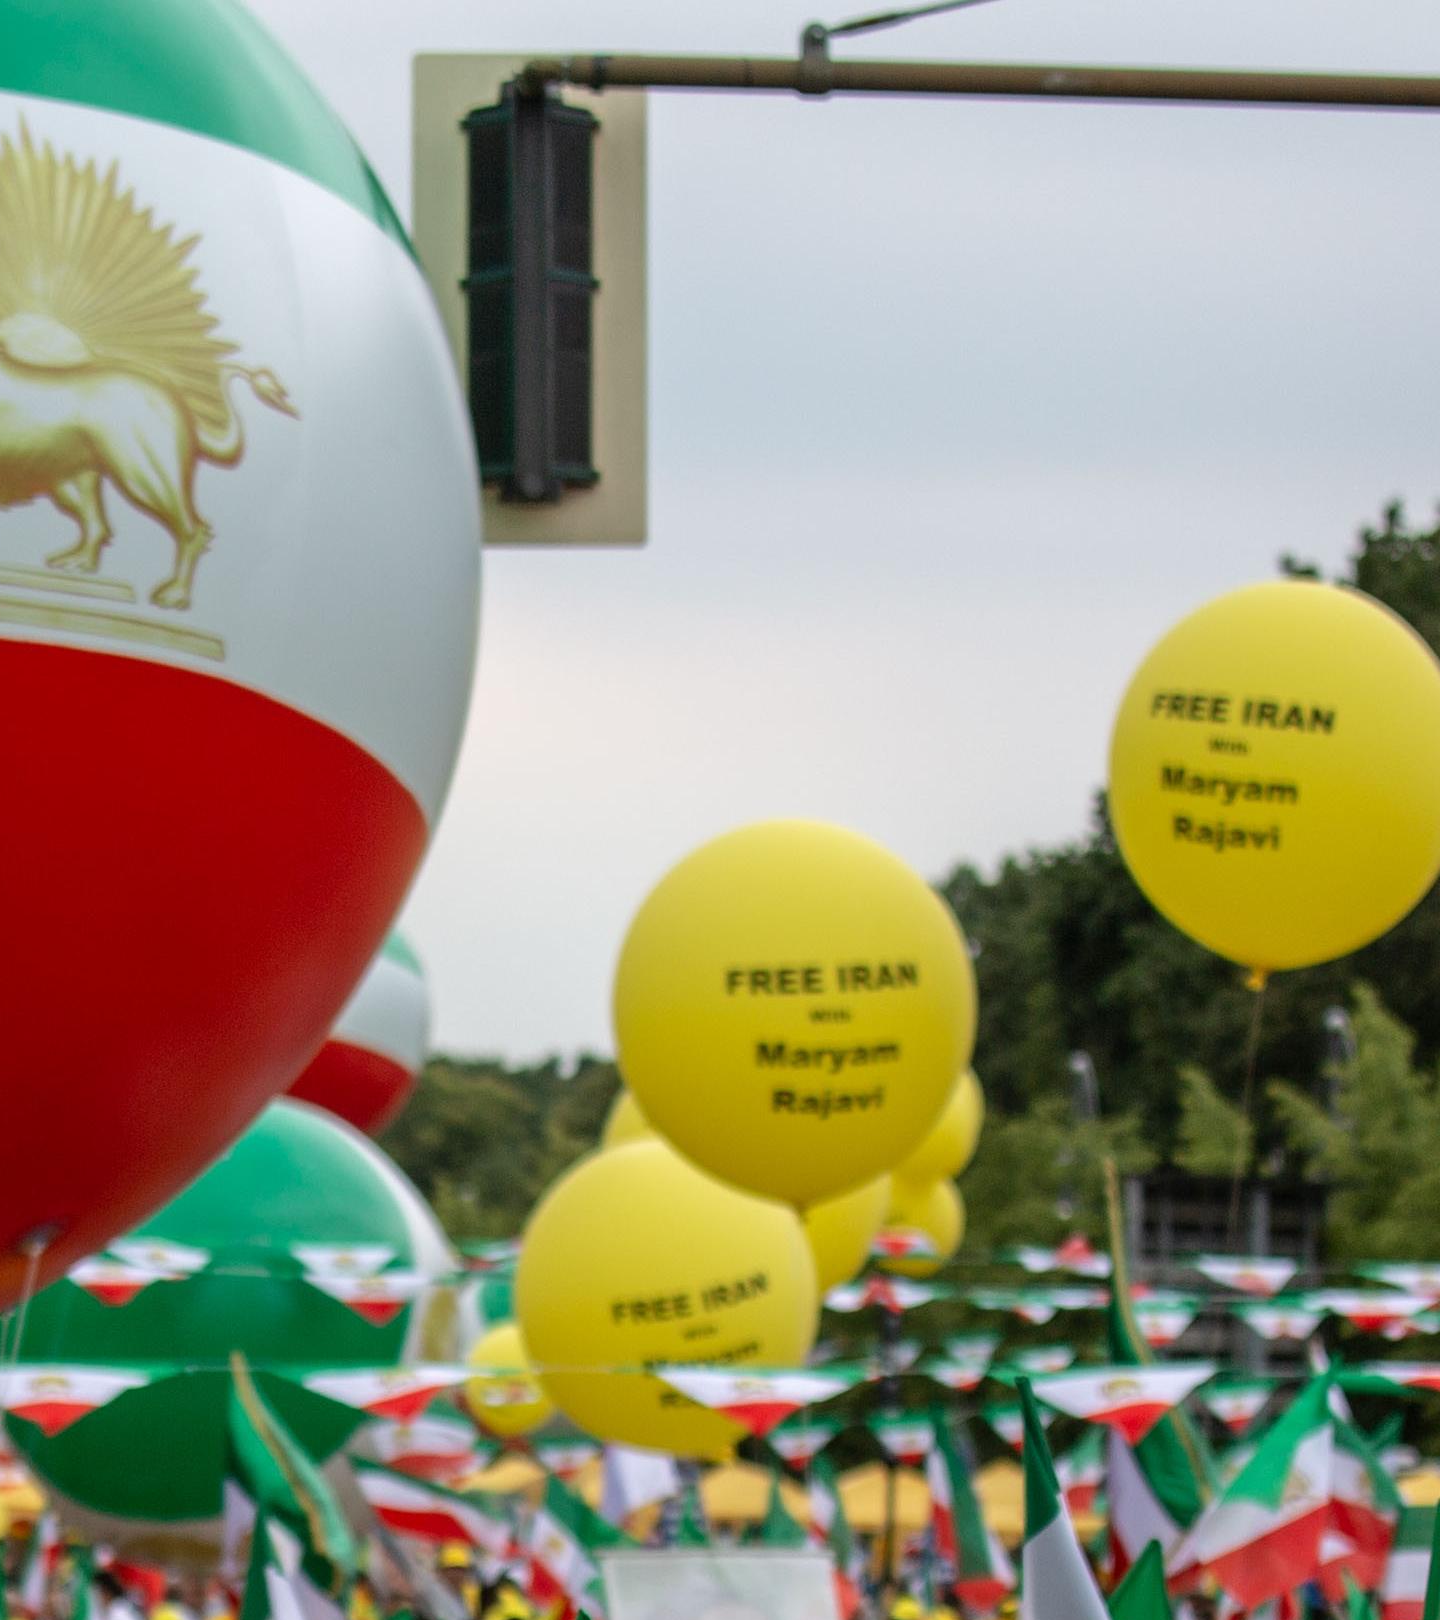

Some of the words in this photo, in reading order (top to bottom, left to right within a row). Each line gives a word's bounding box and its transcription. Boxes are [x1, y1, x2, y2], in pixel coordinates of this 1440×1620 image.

[1152, 690, 1229, 725] FREE
[1242, 698, 1336, 736] IRAN
[1161, 763, 1298, 806] Maryam
[1174, 813, 1280, 853] Rajavi
[724, 965, 825, 997] FREE
[836, 960, 920, 993] IRAN
[755, 1039, 900, 1076] Maryam
[772, 1083, 886, 1121] Rajavi
[610, 1292, 691, 1327] FREE
[700, 1270, 769, 1313] IRAN
